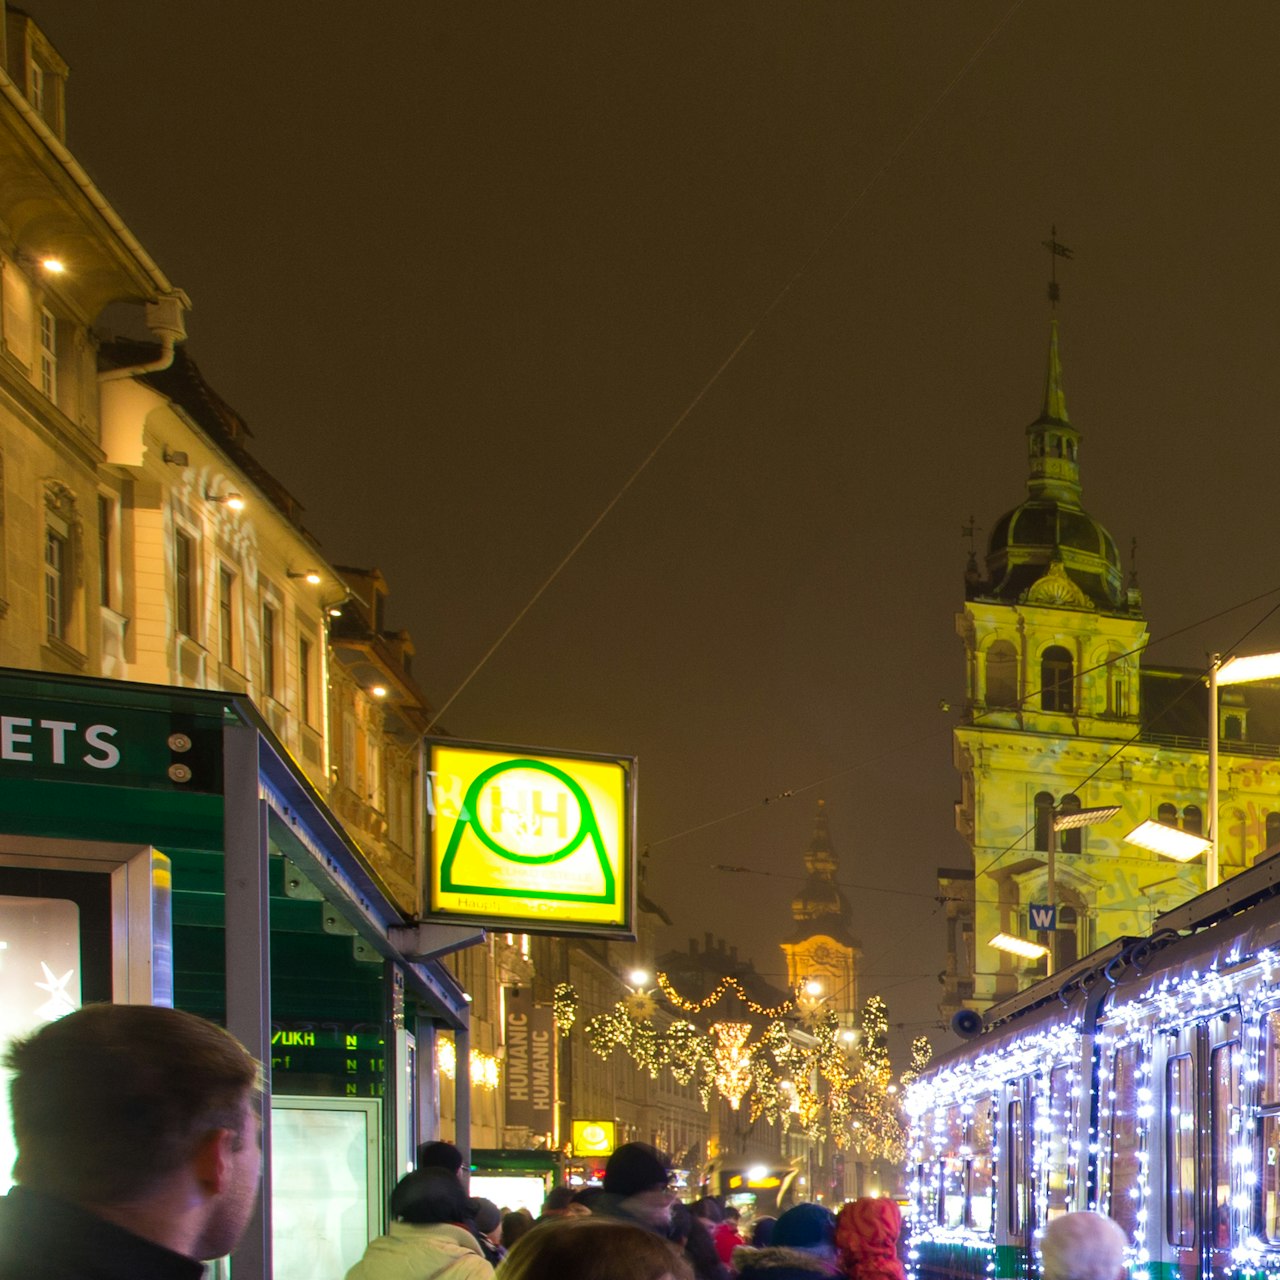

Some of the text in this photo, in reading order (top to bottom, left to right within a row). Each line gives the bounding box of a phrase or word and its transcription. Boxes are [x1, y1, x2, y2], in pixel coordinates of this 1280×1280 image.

[1, 716, 120, 769] ETS
[1031, 908, 1054, 927] W
[508, 1013, 529, 1100] HUMANIC
[532, 1029, 550, 1110] HUMANIC
